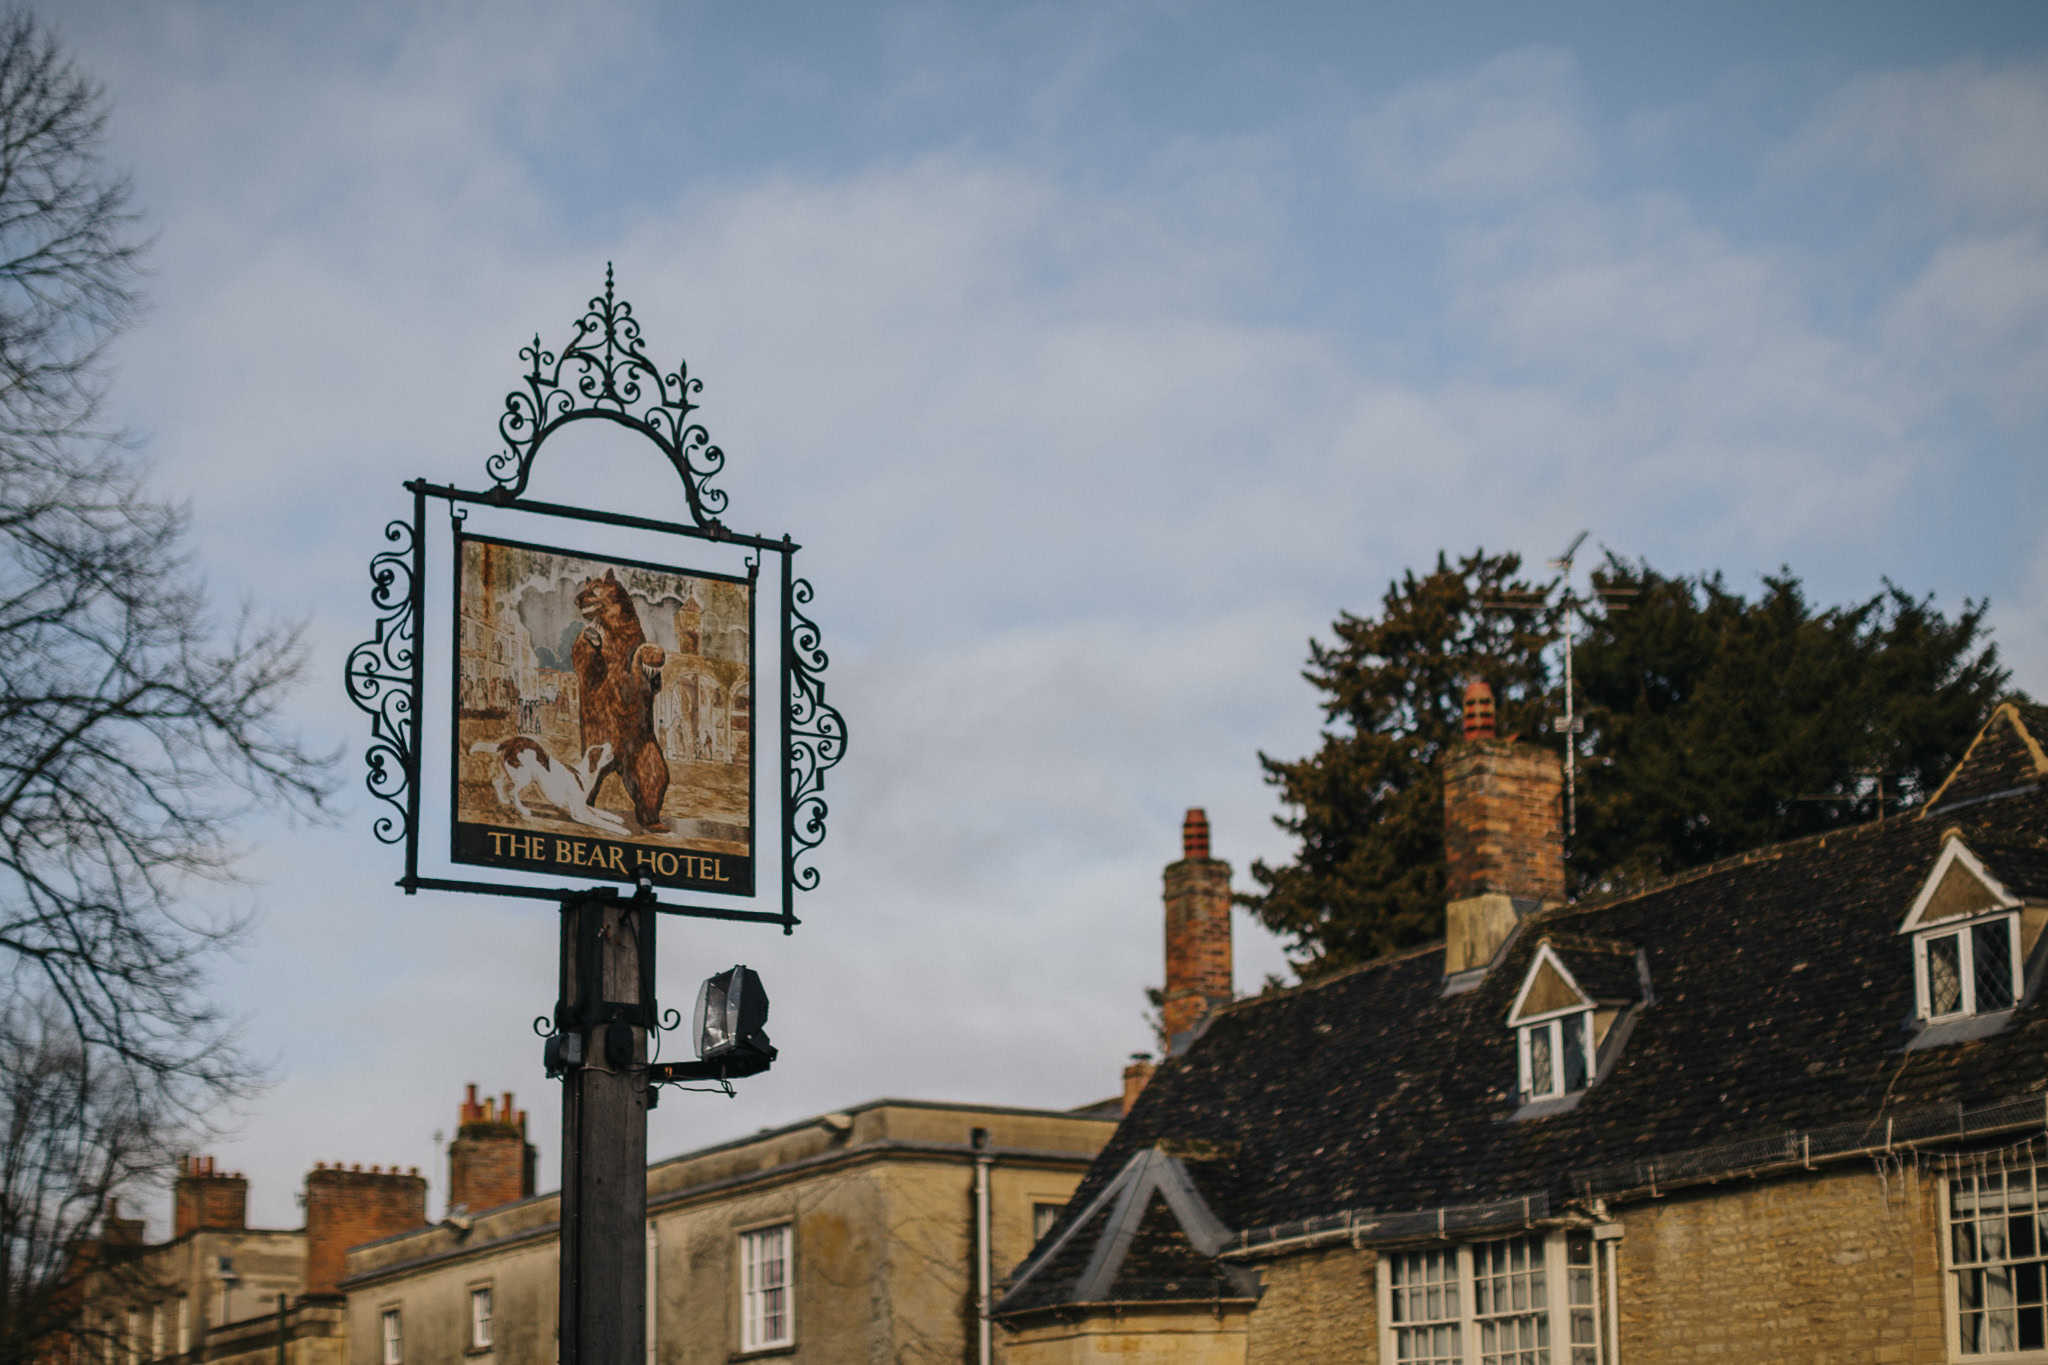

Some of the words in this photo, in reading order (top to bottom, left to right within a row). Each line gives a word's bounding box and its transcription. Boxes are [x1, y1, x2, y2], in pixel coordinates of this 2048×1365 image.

[488, 832, 546, 860] THE
[556, 840, 629, 874] BEAR
[636, 849, 729, 882] HOTEL
